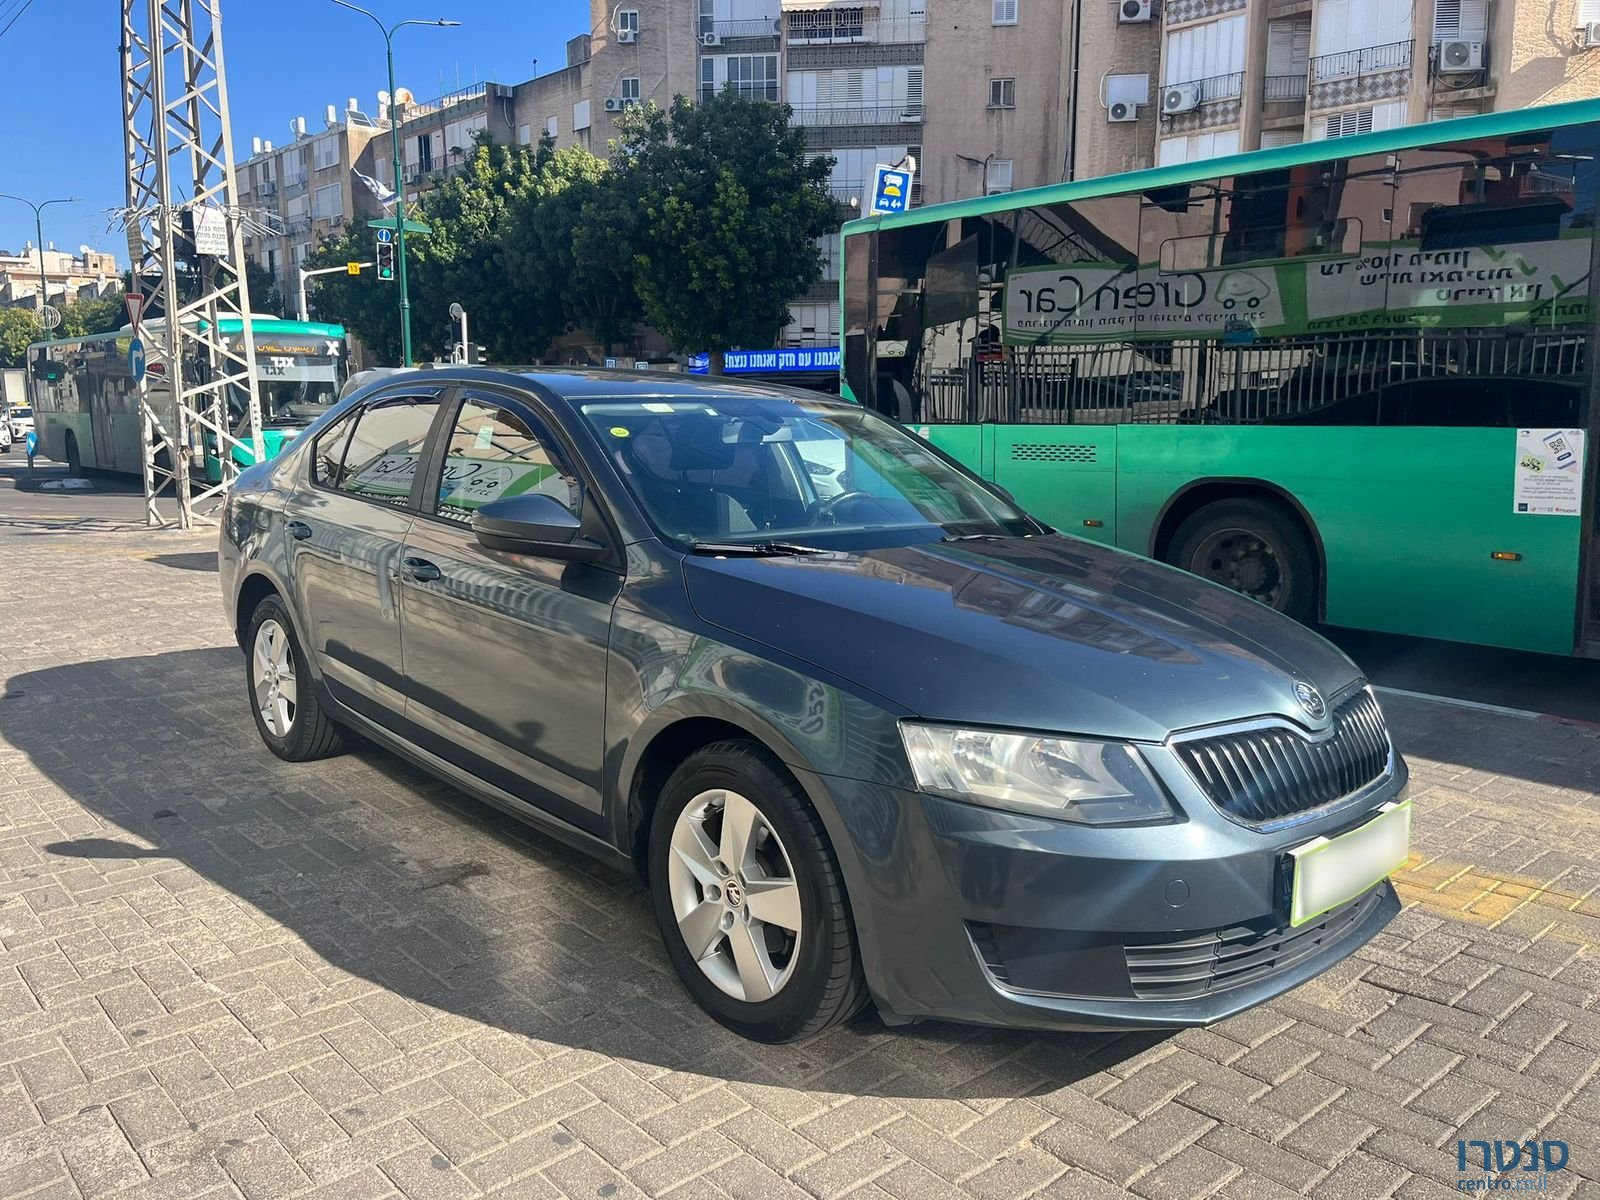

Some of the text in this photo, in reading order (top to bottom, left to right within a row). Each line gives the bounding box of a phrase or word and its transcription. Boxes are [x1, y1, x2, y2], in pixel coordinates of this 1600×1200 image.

[725, 351, 840, 370] אנחנו עם חזק ואנחנו ננצח!
